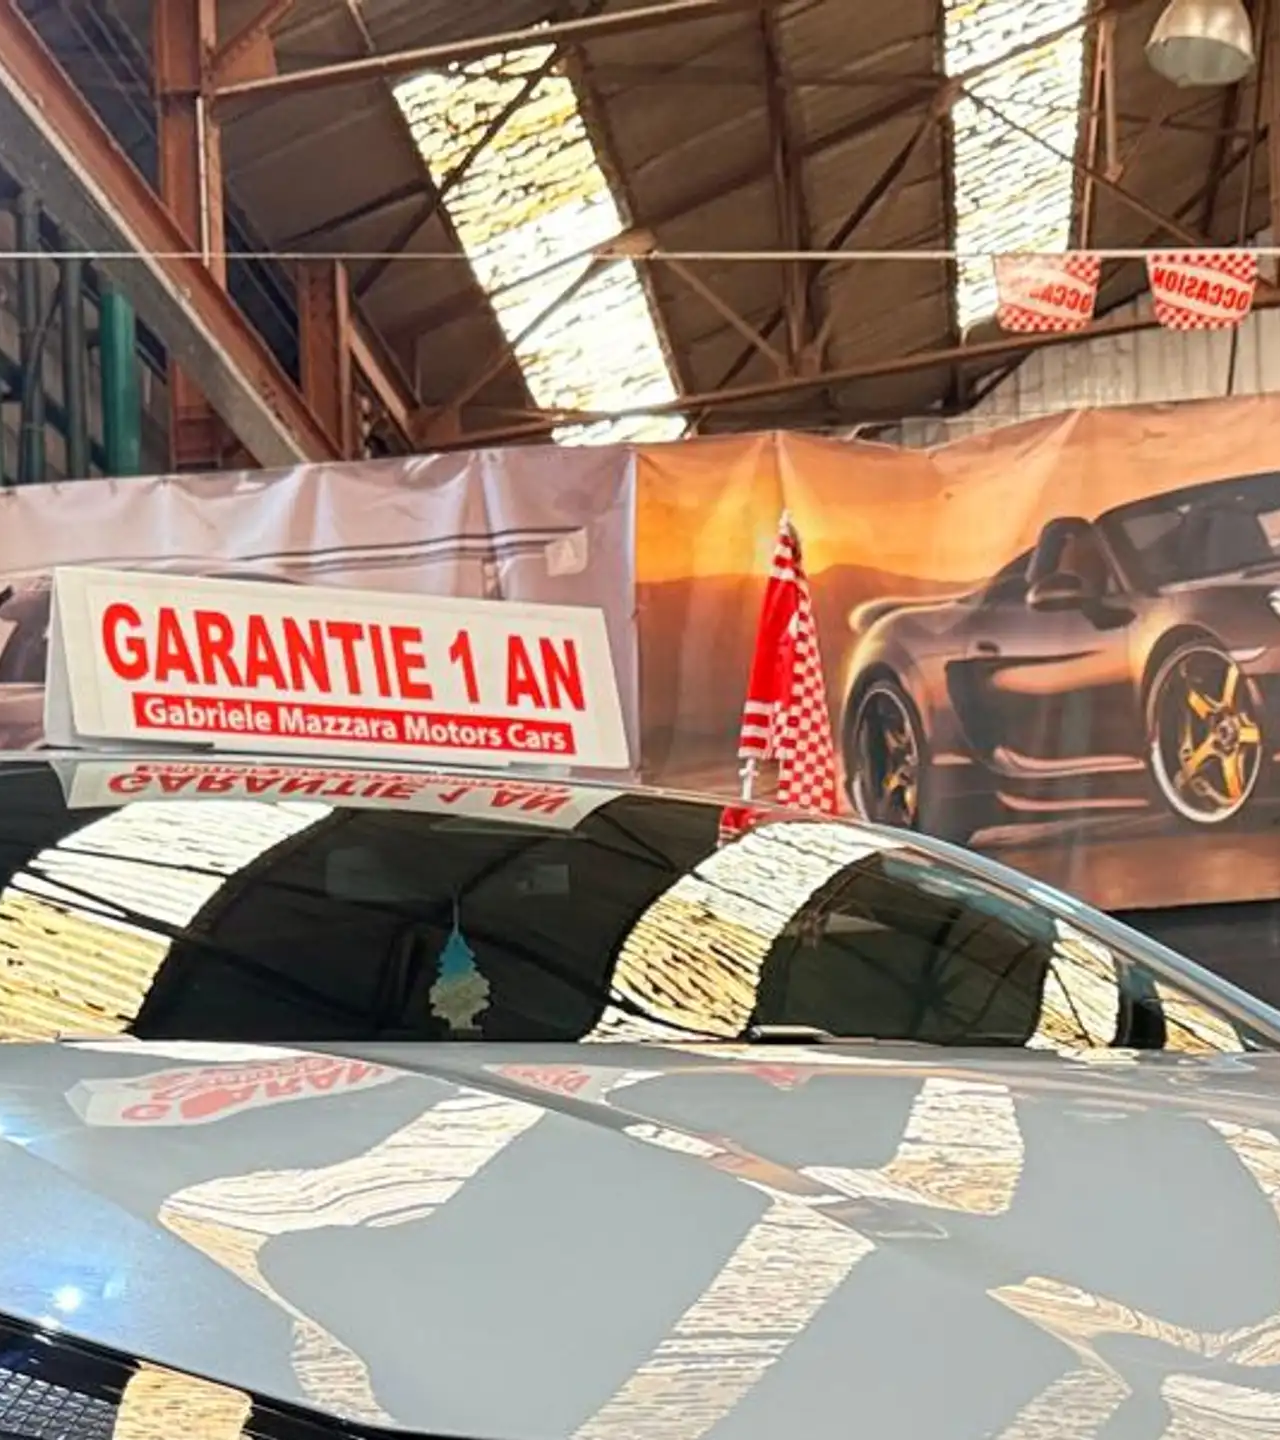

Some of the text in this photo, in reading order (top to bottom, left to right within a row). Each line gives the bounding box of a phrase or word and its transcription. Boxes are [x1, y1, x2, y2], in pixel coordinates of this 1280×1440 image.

[102, 602, 585, 711] GARANTIE 1 AN
[144, 697, 566, 750] Gabriele Mazzara Motors Cars
